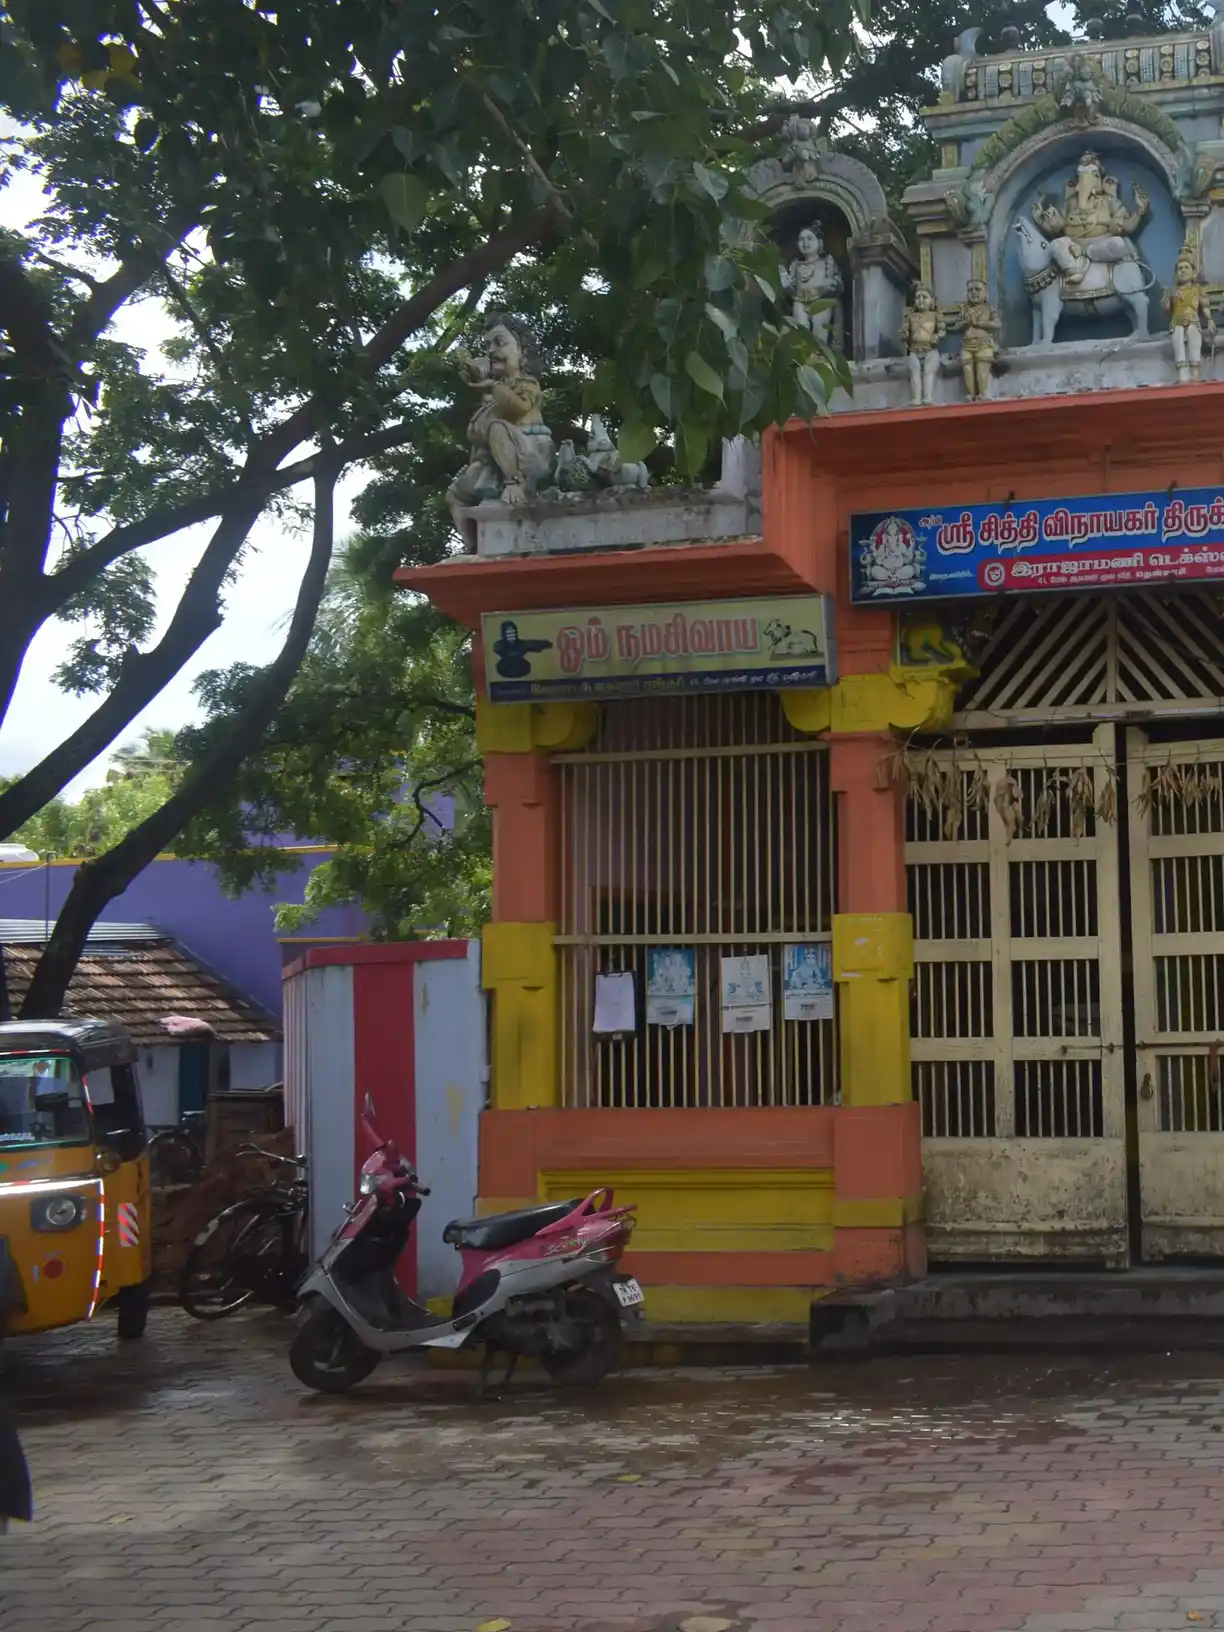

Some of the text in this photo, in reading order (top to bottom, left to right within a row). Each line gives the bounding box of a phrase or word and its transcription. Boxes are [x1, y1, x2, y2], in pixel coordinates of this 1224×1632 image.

[979, 510, 1039, 554] சித்தி
[1043, 502, 1159, 549] விநாயகர்
[1011, 552, 1144, 577] இராஜாமணி
[557, 612, 760, 675] ஓம் நமசிவாய
